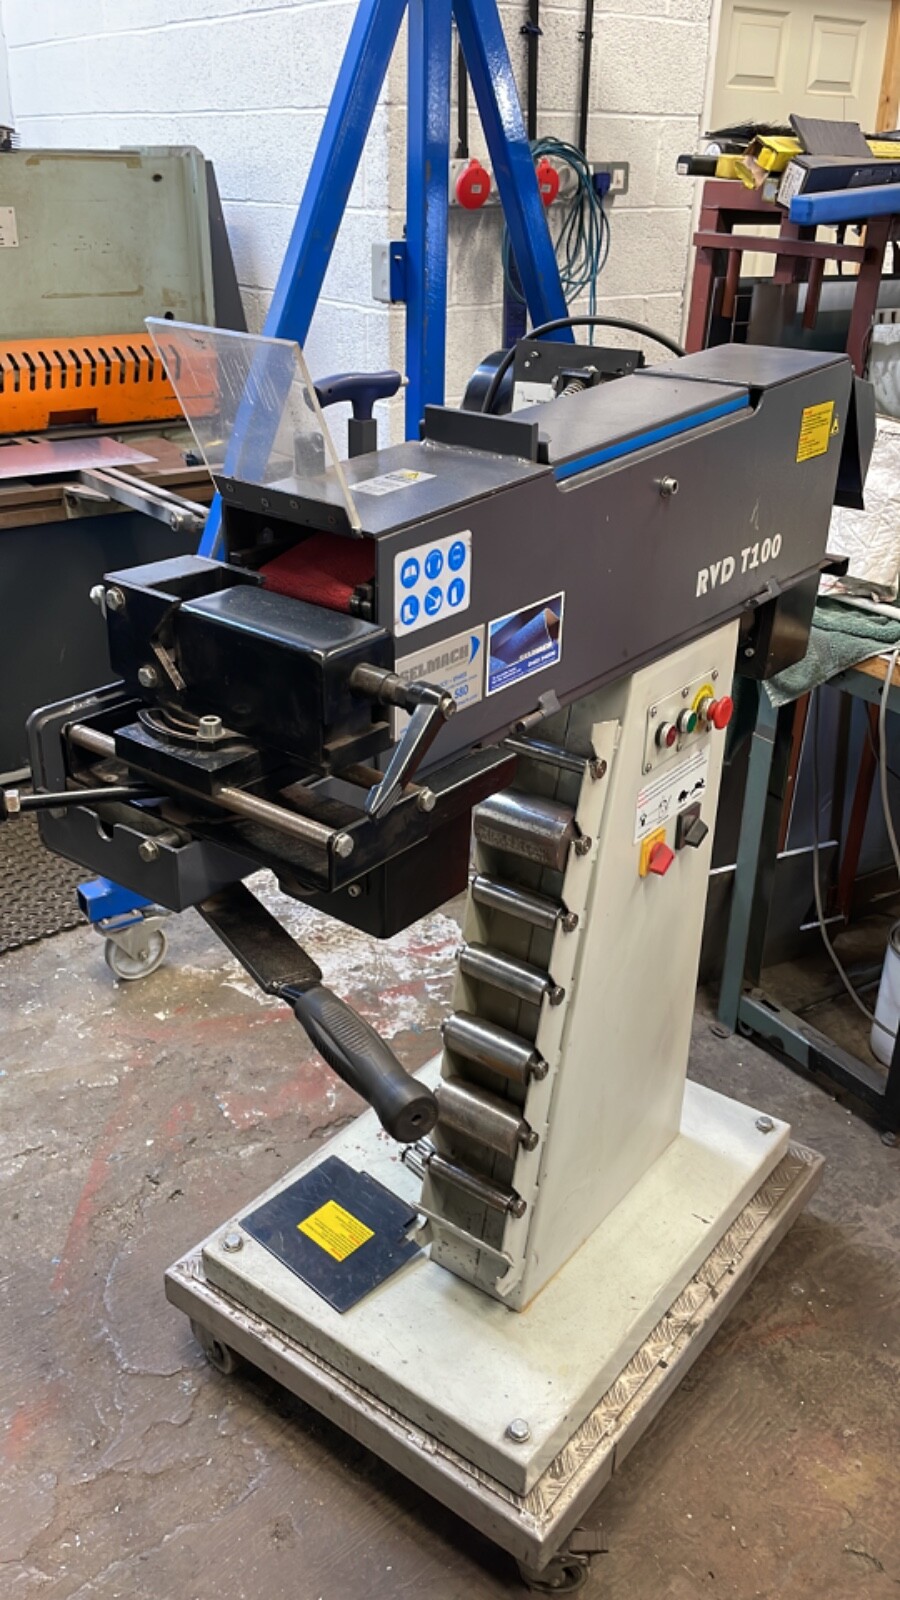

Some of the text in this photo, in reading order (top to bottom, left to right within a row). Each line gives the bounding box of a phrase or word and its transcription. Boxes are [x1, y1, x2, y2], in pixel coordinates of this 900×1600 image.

[696, 533, 782, 597] RVD T100
[399, 644, 469, 681] SELMACH
